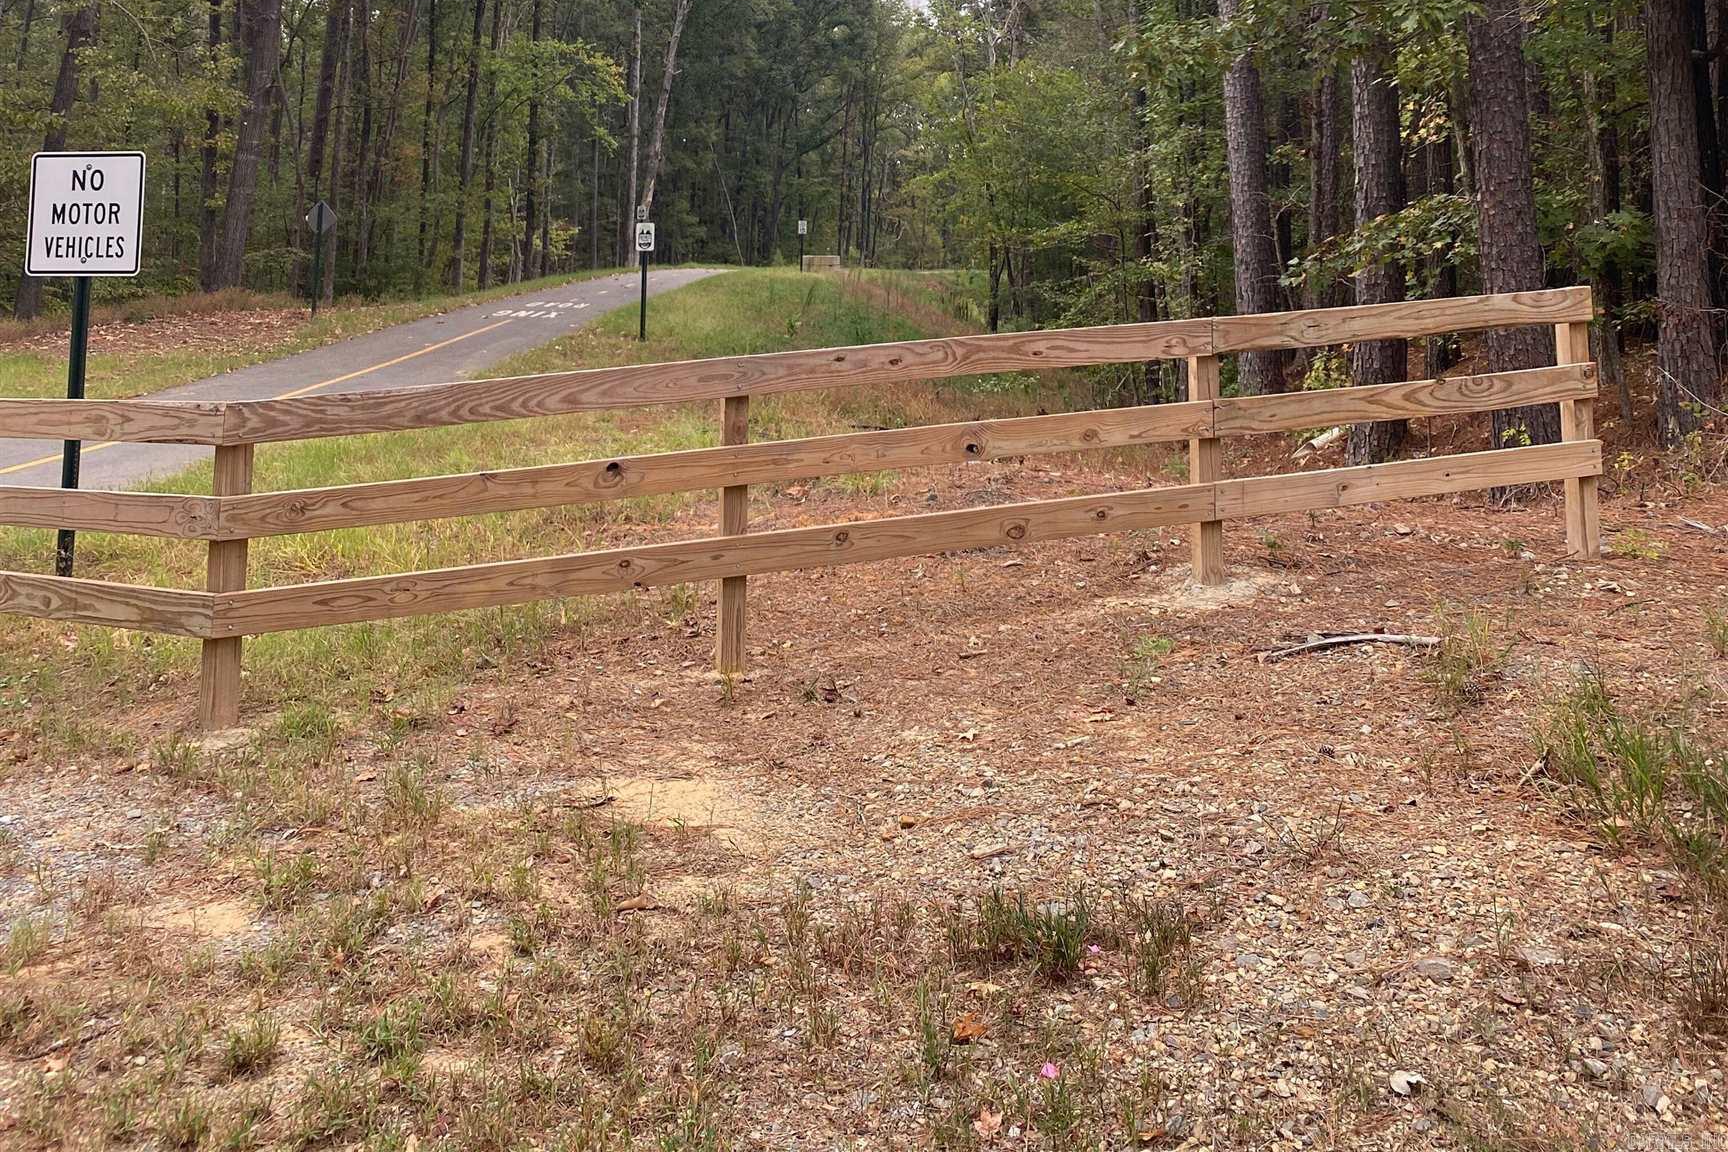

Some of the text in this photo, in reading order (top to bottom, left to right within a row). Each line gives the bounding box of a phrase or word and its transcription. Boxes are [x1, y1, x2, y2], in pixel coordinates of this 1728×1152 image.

[71, 169, 104, 191] NO
[51, 203, 121, 225] MOTOR
[45, 236, 125, 258] VEHICLES
[492, 310, 564, 318] XING
